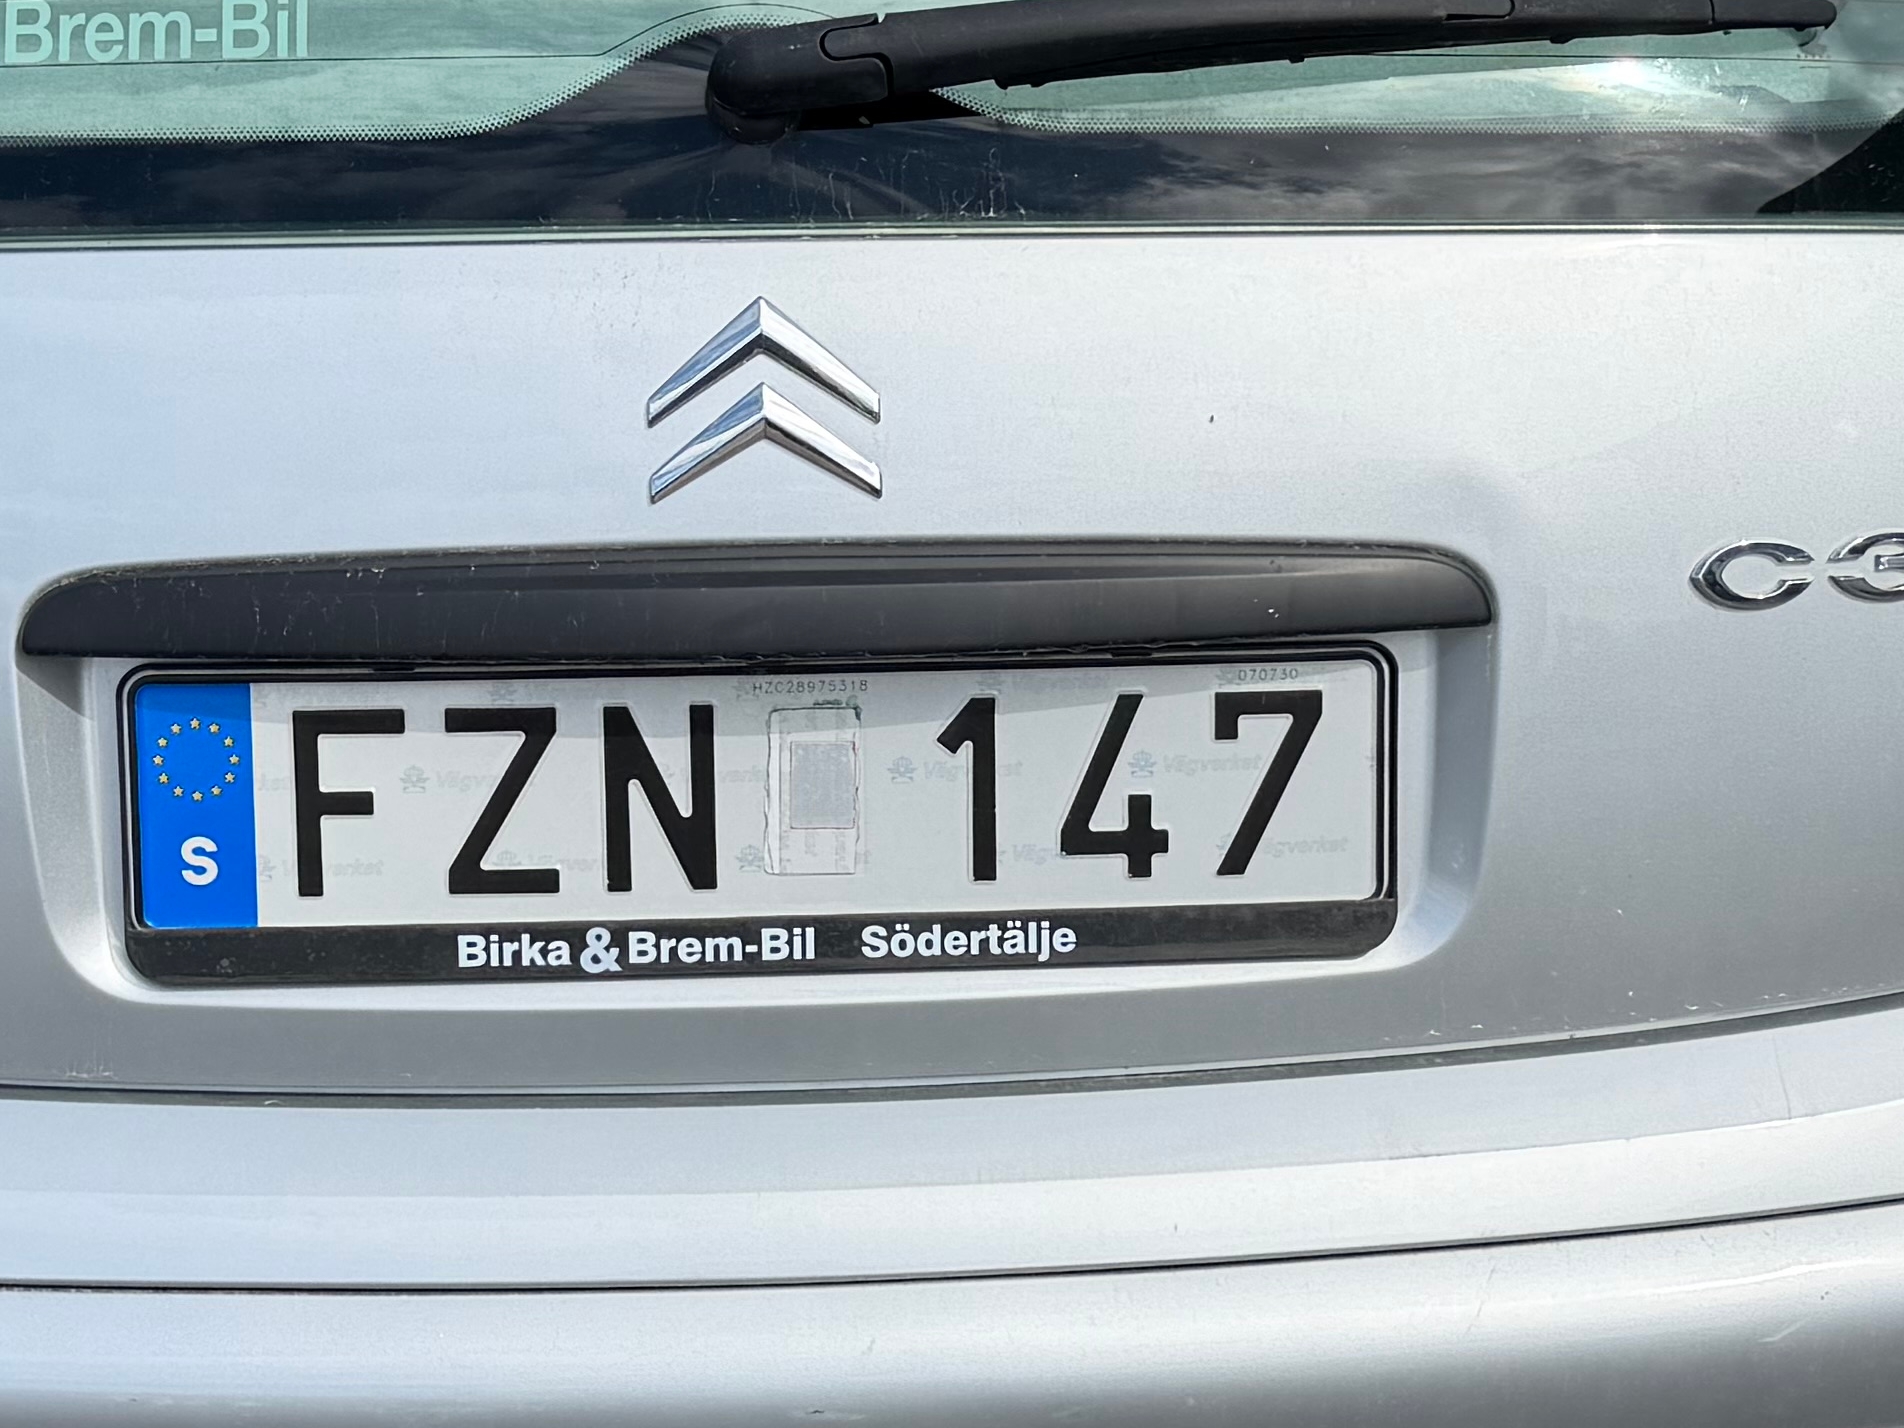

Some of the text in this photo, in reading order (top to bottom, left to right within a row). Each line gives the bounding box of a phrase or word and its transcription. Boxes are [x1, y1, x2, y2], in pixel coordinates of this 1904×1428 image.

[1237, 668, 1300, 682] 070730
[291, 688, 1323, 898] FZN 147
[180, 835, 219, 886] S
[456, 920, 1078, 974] Birka & Brem-Bil Södertälje
